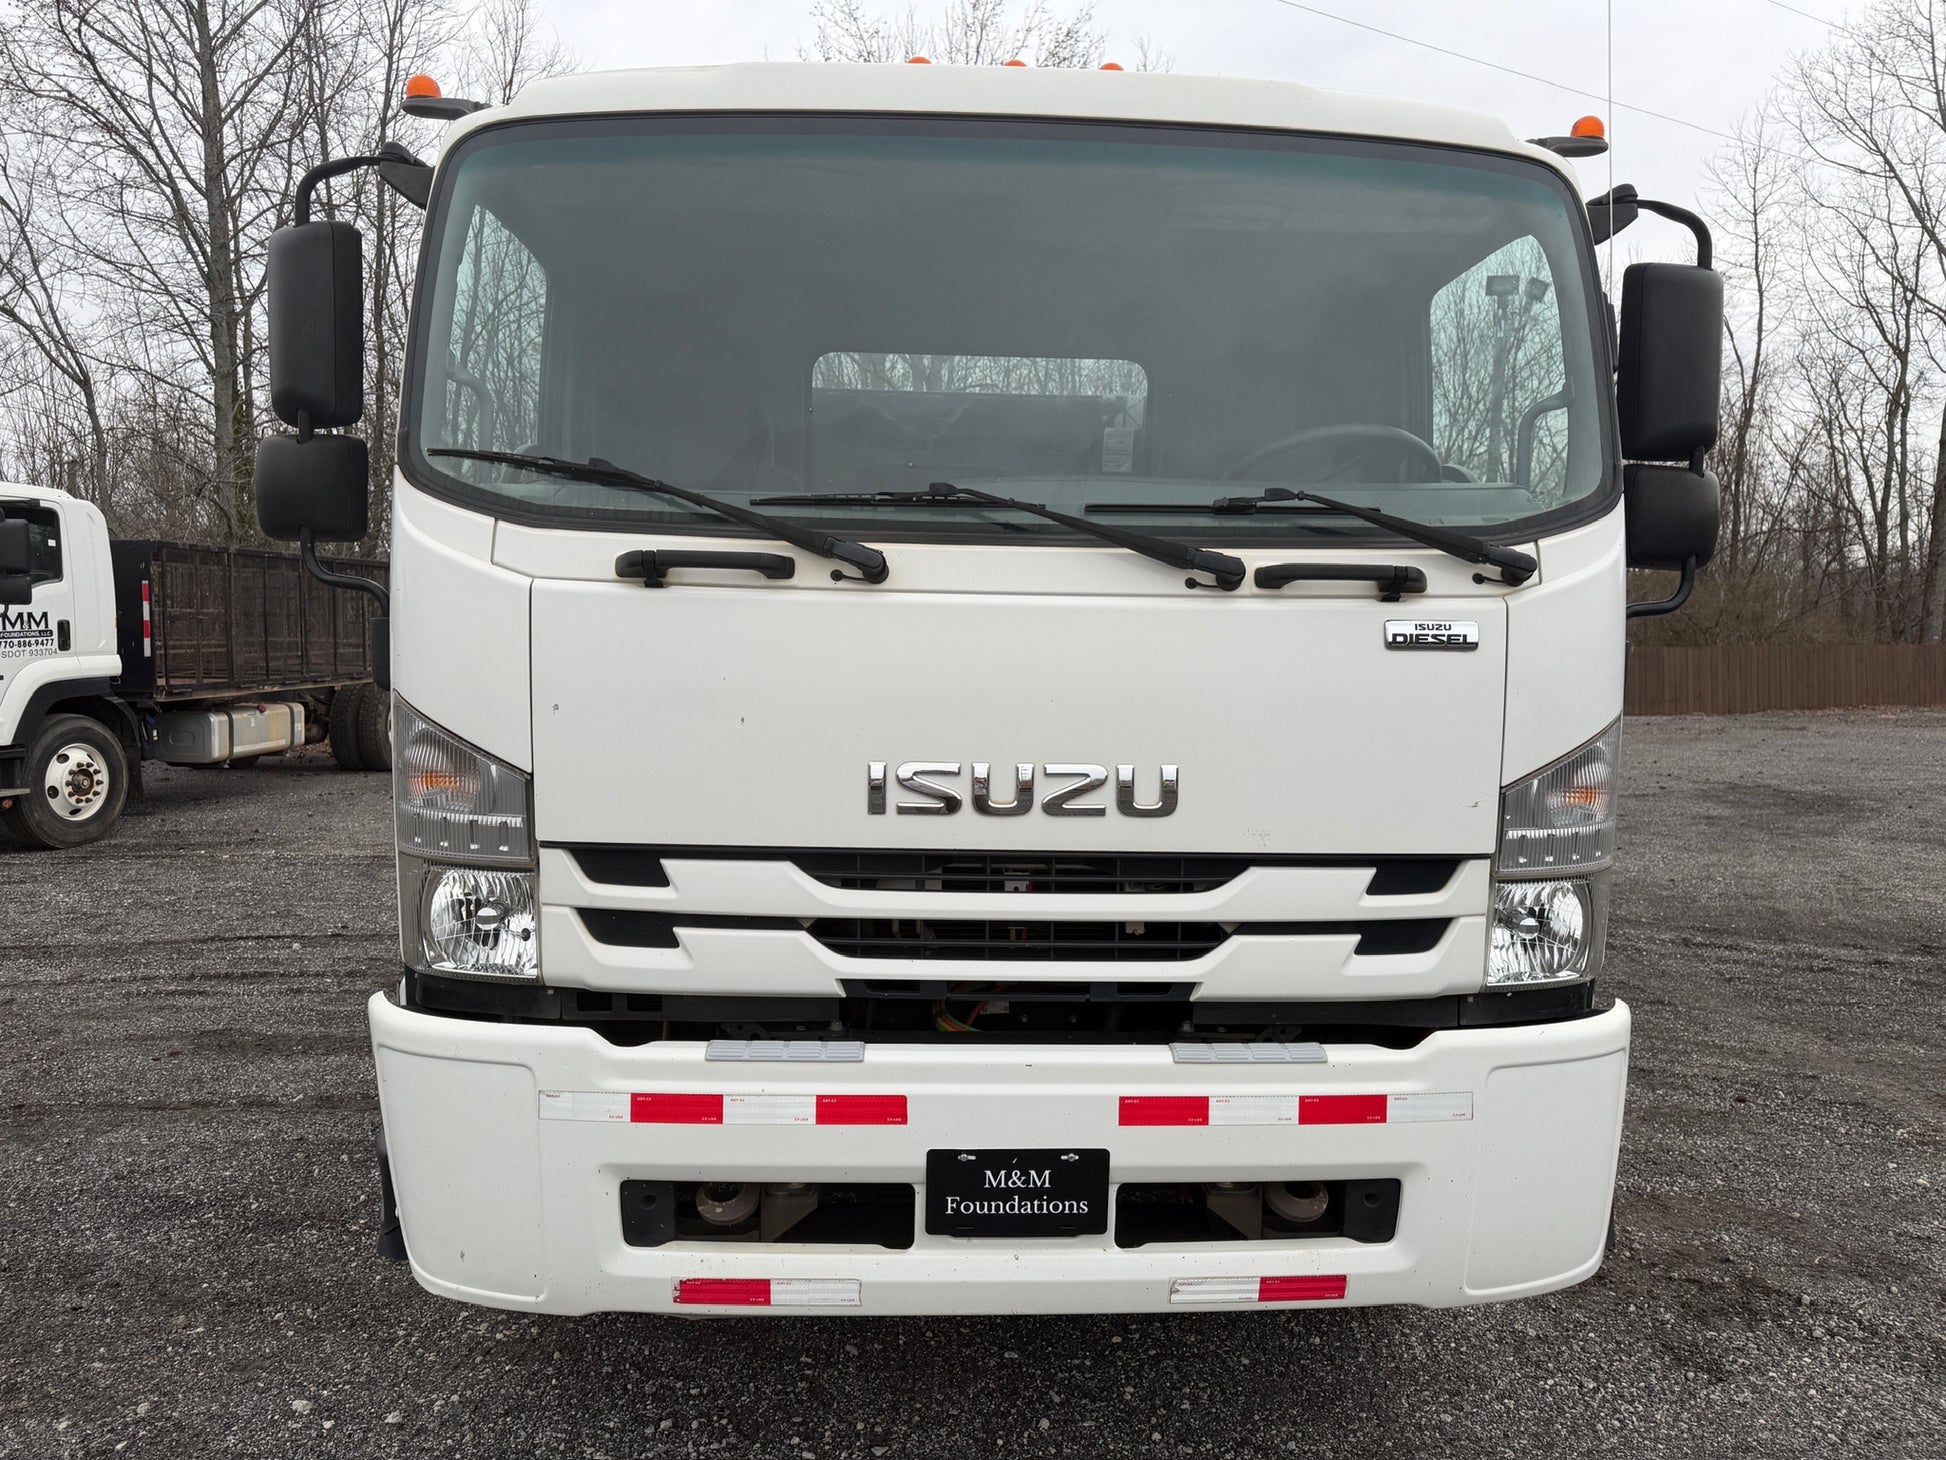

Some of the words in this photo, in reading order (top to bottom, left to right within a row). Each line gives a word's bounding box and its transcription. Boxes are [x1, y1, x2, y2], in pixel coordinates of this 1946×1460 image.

[1415, 623, 1452, 631] ISUZU
[1391, 633, 1475, 646] DIESEL
[1, 649, 26, 658] SDOT
[29, 648, 58, 656] 933704
[866, 761, 1179, 818] ISUZU
[983, 1168, 1052, 1189] M&M
[945, 1195, 1089, 1215] Foundations
